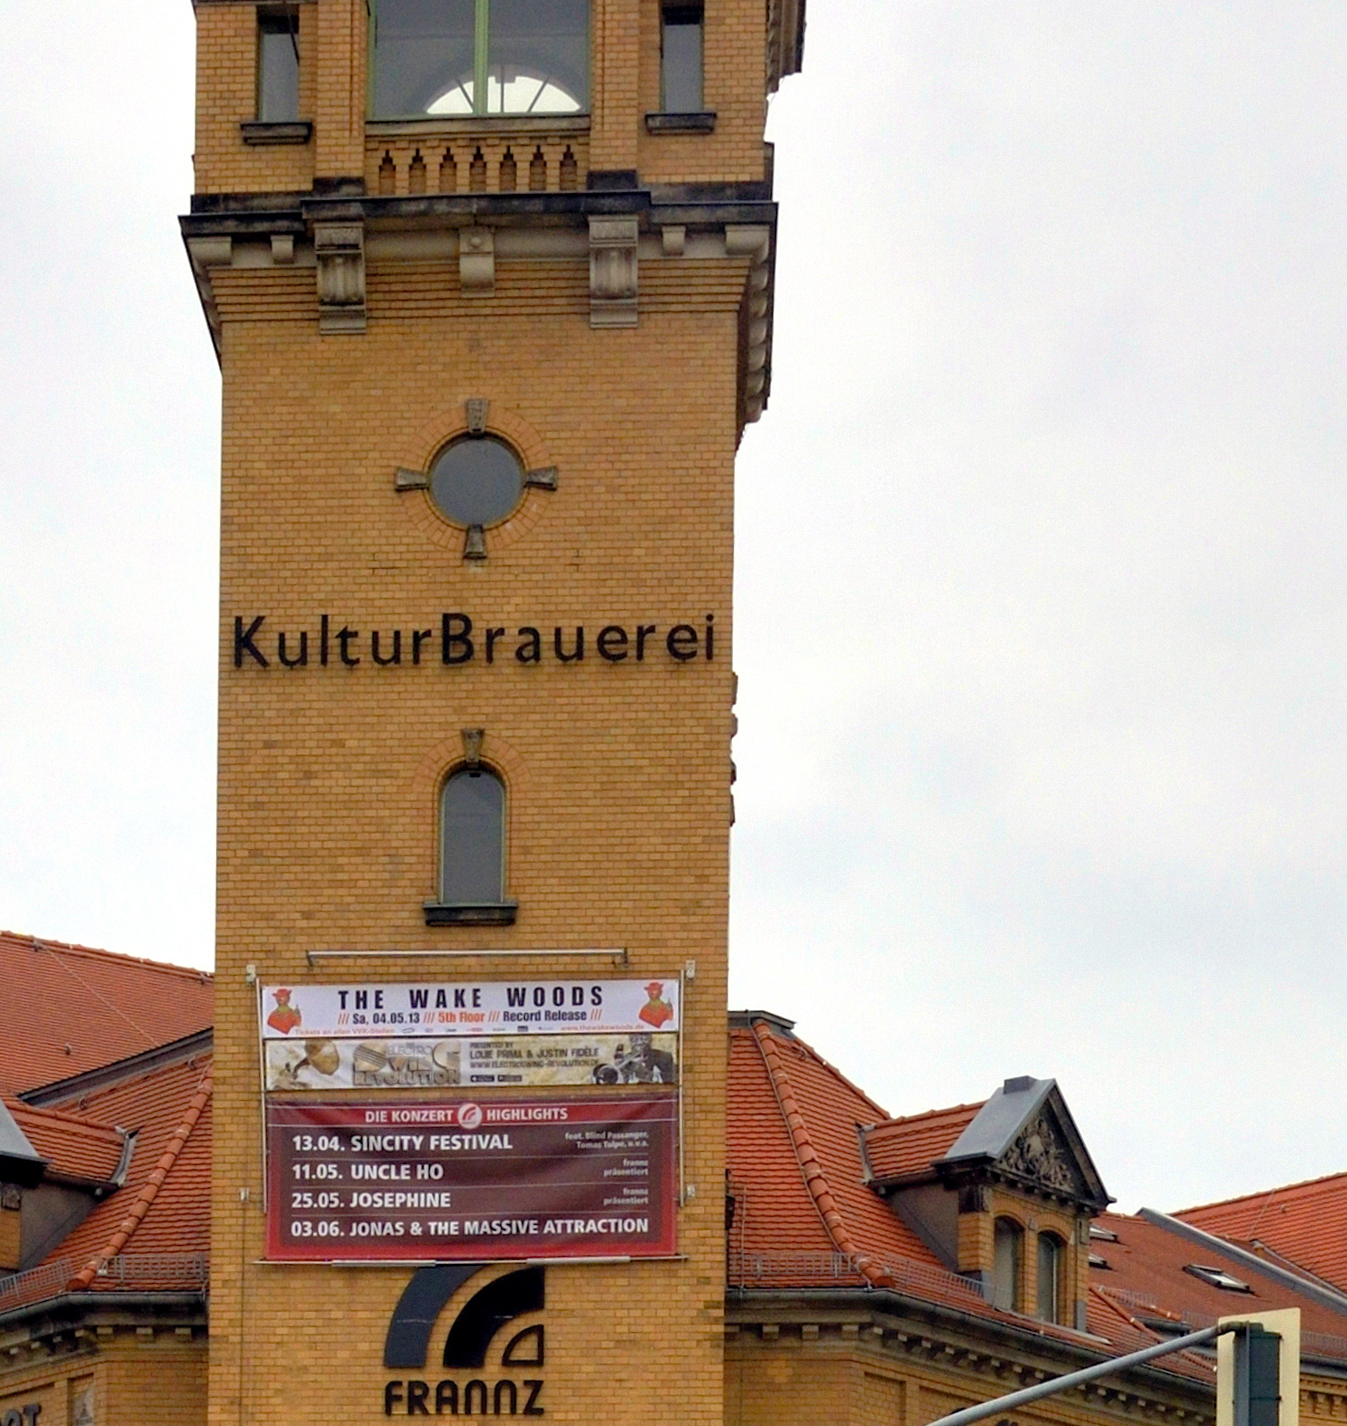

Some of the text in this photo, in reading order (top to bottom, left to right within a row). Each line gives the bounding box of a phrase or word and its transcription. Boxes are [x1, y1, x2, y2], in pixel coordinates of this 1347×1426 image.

[232, 612, 716, 668] KulturBrauerei
[337, 986, 603, 1010] THE WAKE WOODS
[352, 1013, 370, 1026] Sa,
[372, 1012, 420, 1024] 04.05.13
[438, 1012, 456, 1023] 5th
[459, 1011, 486, 1023] Floor
[502, 1011, 541, 1022] Record
[544, 1010, 587, 1022] Release
[527, 1049, 533, 1058] &
[537, 1048, 567, 1058] JUSTIN
[365, 1110, 454, 1123] DIE KONZERT
[486, 1108, 568, 1121] HIGHLIGHTS
[292, 1134, 513, 1152] 13.04. SINCITY FESTIVAL
[292, 1163, 444, 1180] 11.05. UNCLE HO
[291, 1192, 451, 1208] 25.05. JOSEPHINE
[291, 1218, 649, 1237] 03.06. JONAS & THE MASSIVE ATTRACTION
[384, 1379, 545, 1417] FRANNZ
